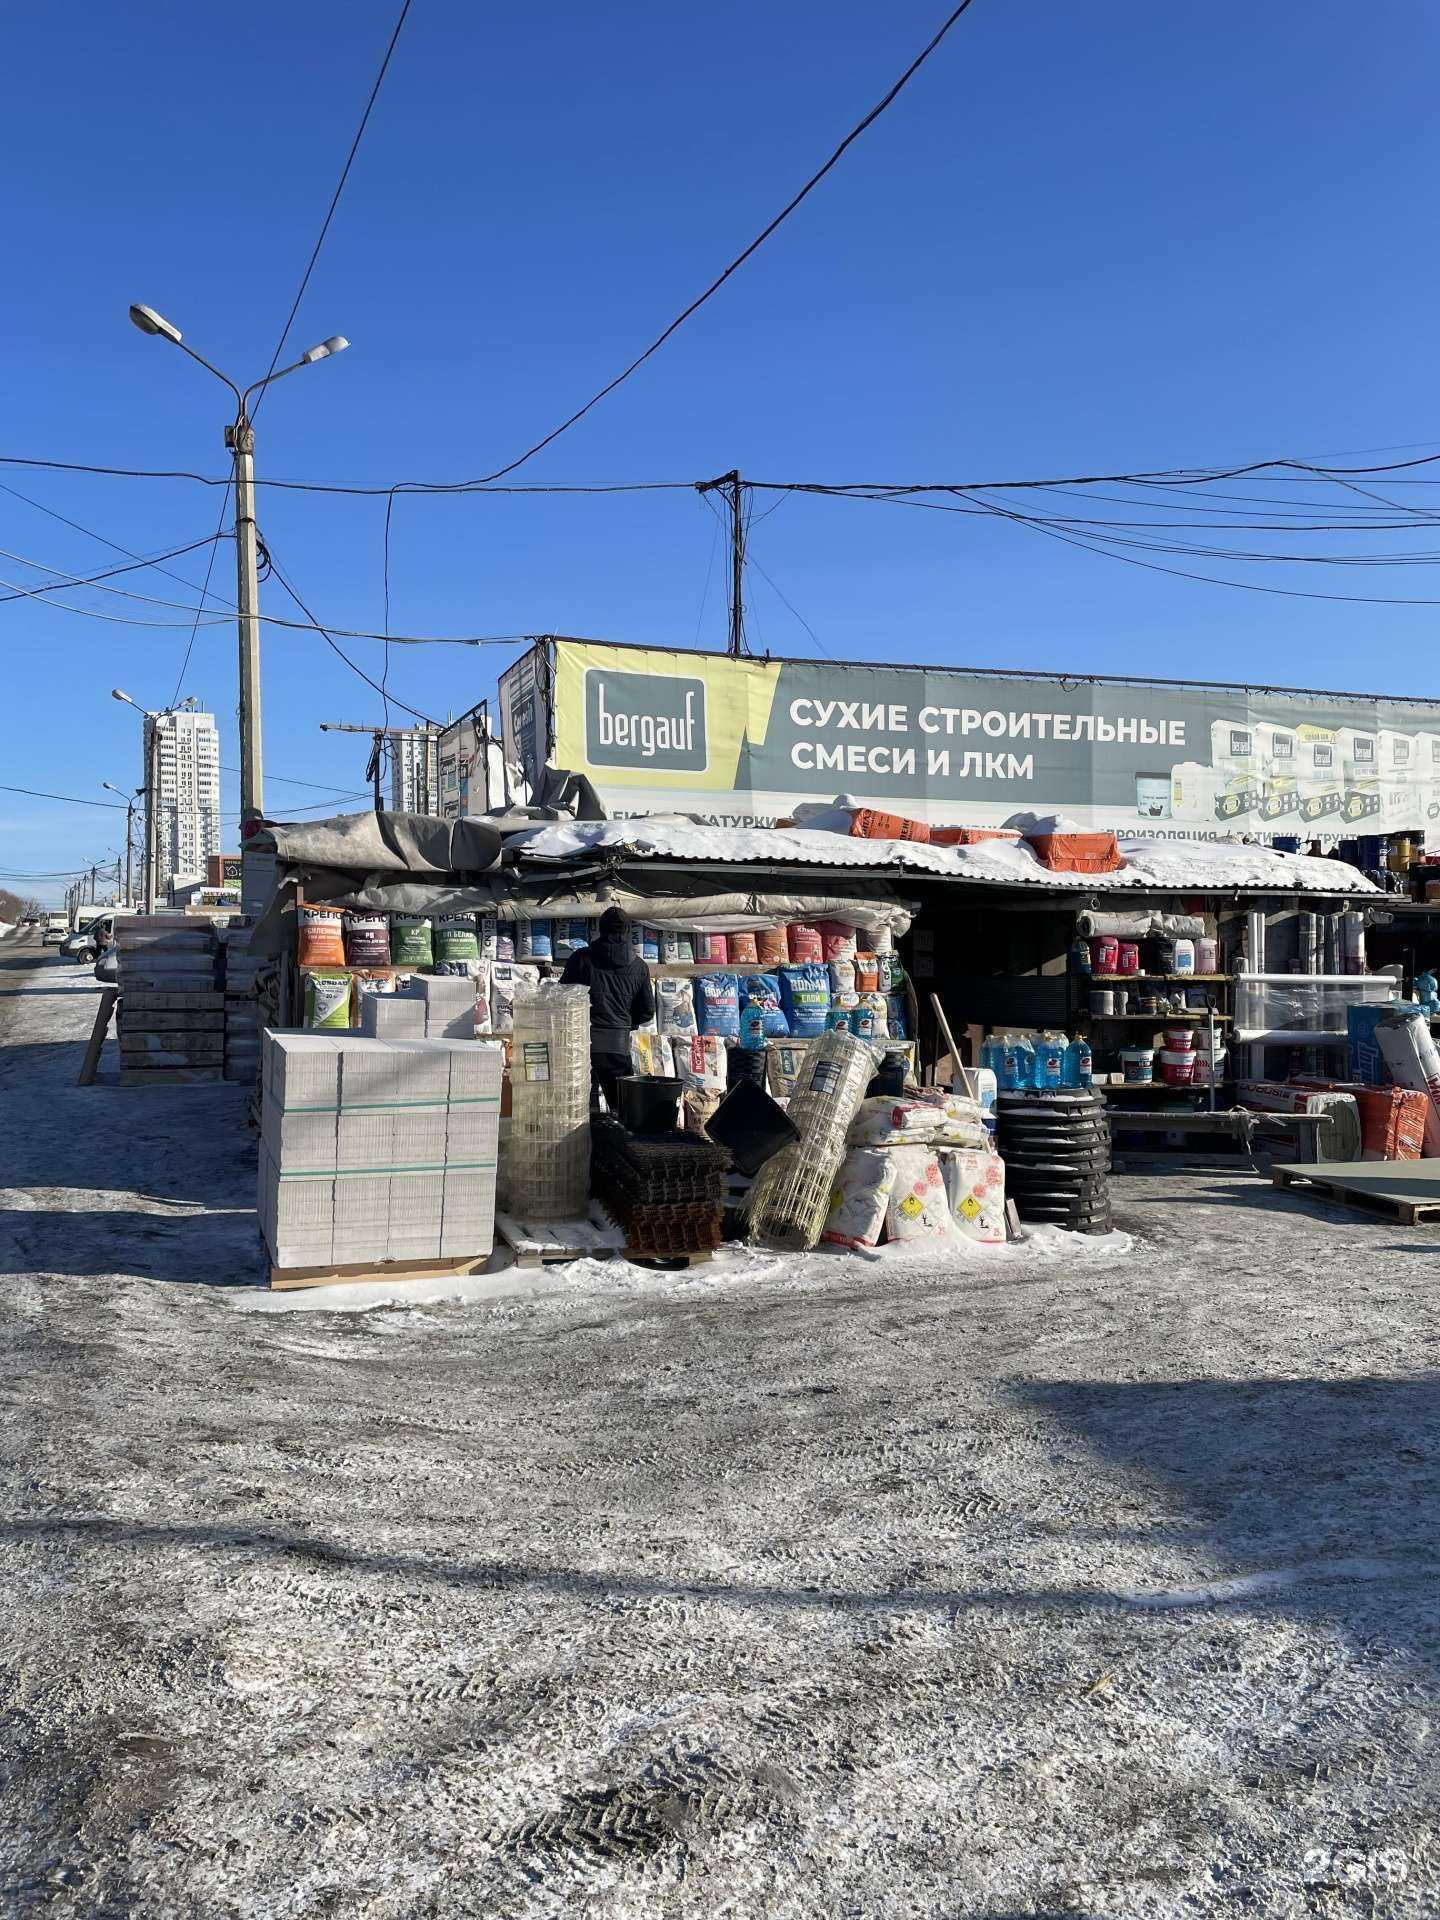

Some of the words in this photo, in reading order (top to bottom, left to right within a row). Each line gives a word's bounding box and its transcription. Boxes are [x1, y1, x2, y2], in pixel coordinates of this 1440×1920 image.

[599, 683, 695, 757] bergauf
[789, 698, 908, 732] СУХИЕ
[918, 706, 1186, 746] СТРОИТЕЛЬНЫЕ
[791, 741, 915, 775] СМЕСИ
[927, 749, 950, 776] И
[959, 751, 1034, 780] ЛКМ
